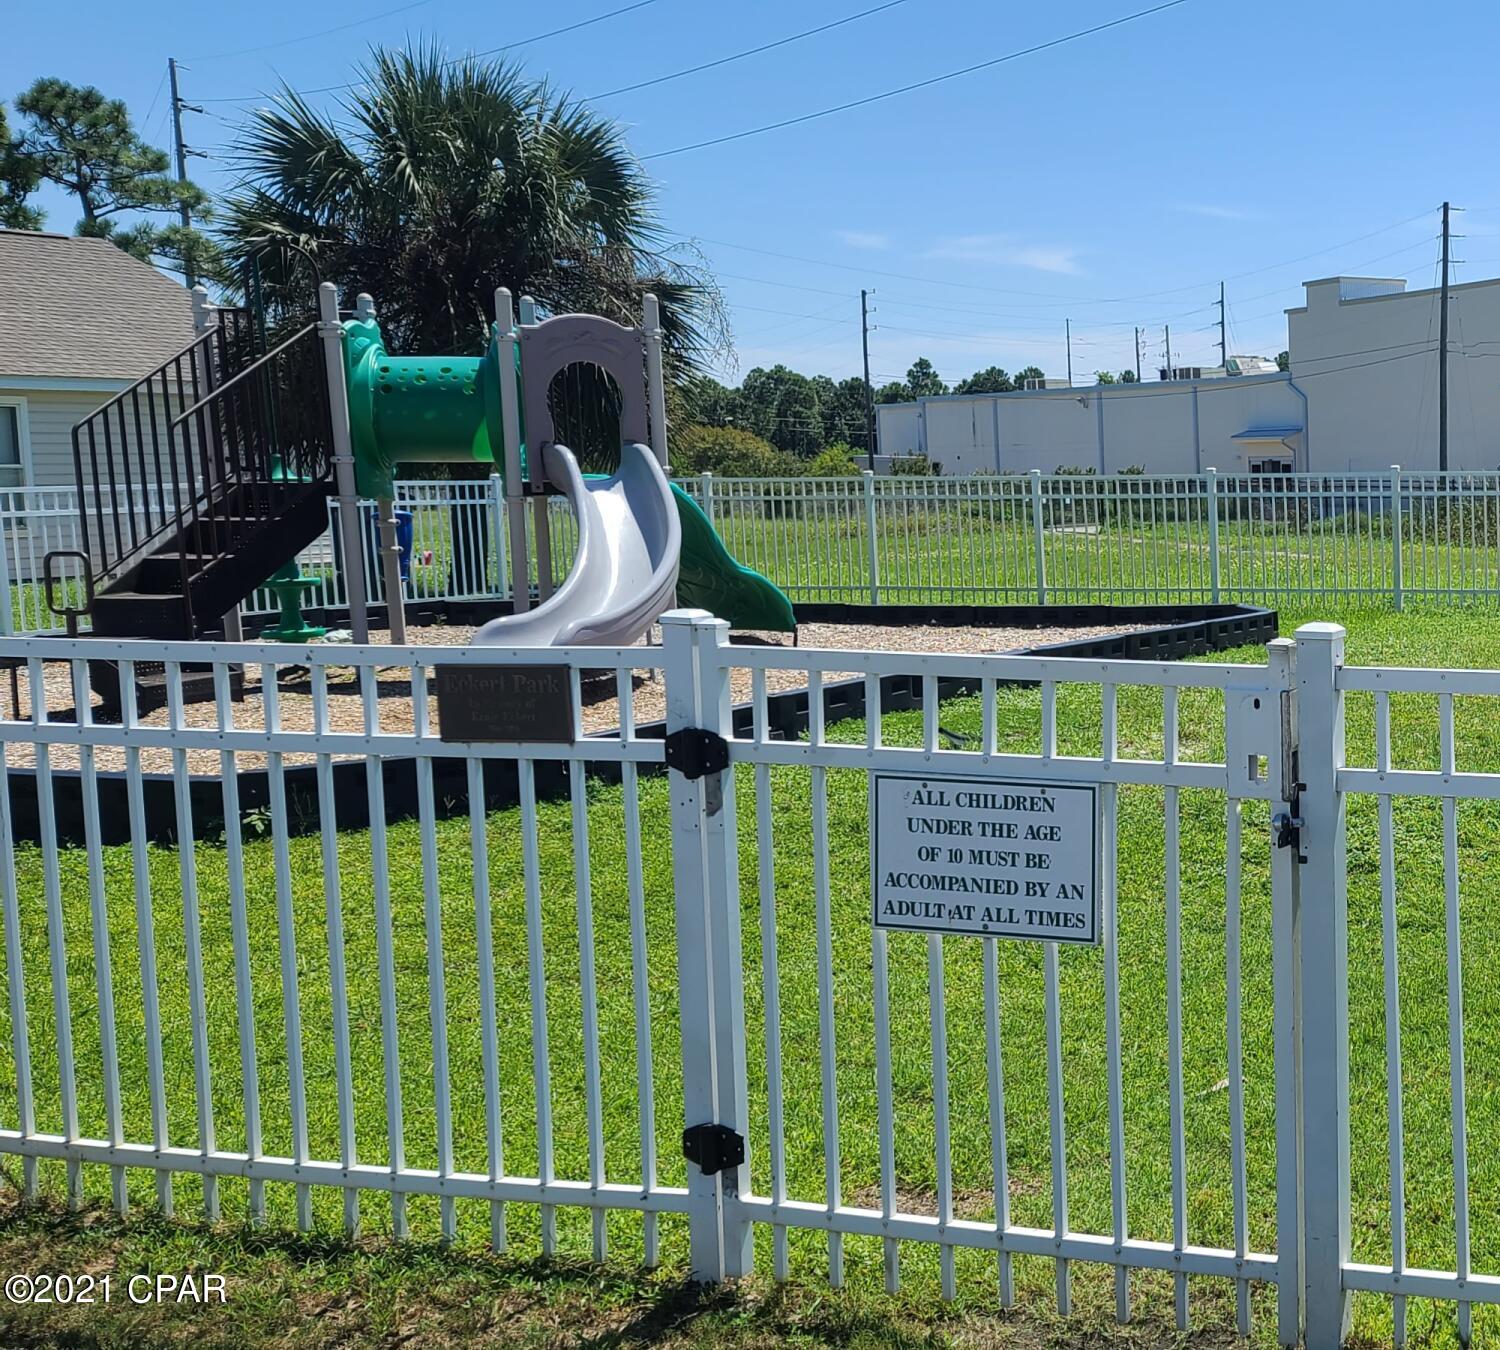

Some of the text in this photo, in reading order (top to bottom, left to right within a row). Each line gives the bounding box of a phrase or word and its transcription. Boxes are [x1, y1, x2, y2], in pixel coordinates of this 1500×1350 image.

[444, 674, 560, 694] Eckert Park
[912, 790, 1056, 812] ALL CHILDREN
[907, 817, 1061, 842] UNDER THE AGE
[917, 846, 1051, 869] OF 10 MUST BE
[884, 872, 1085, 900] ACCOMPANIED BY AN
[883, 899, 1086, 929] ADULT AT ALL TIMES
